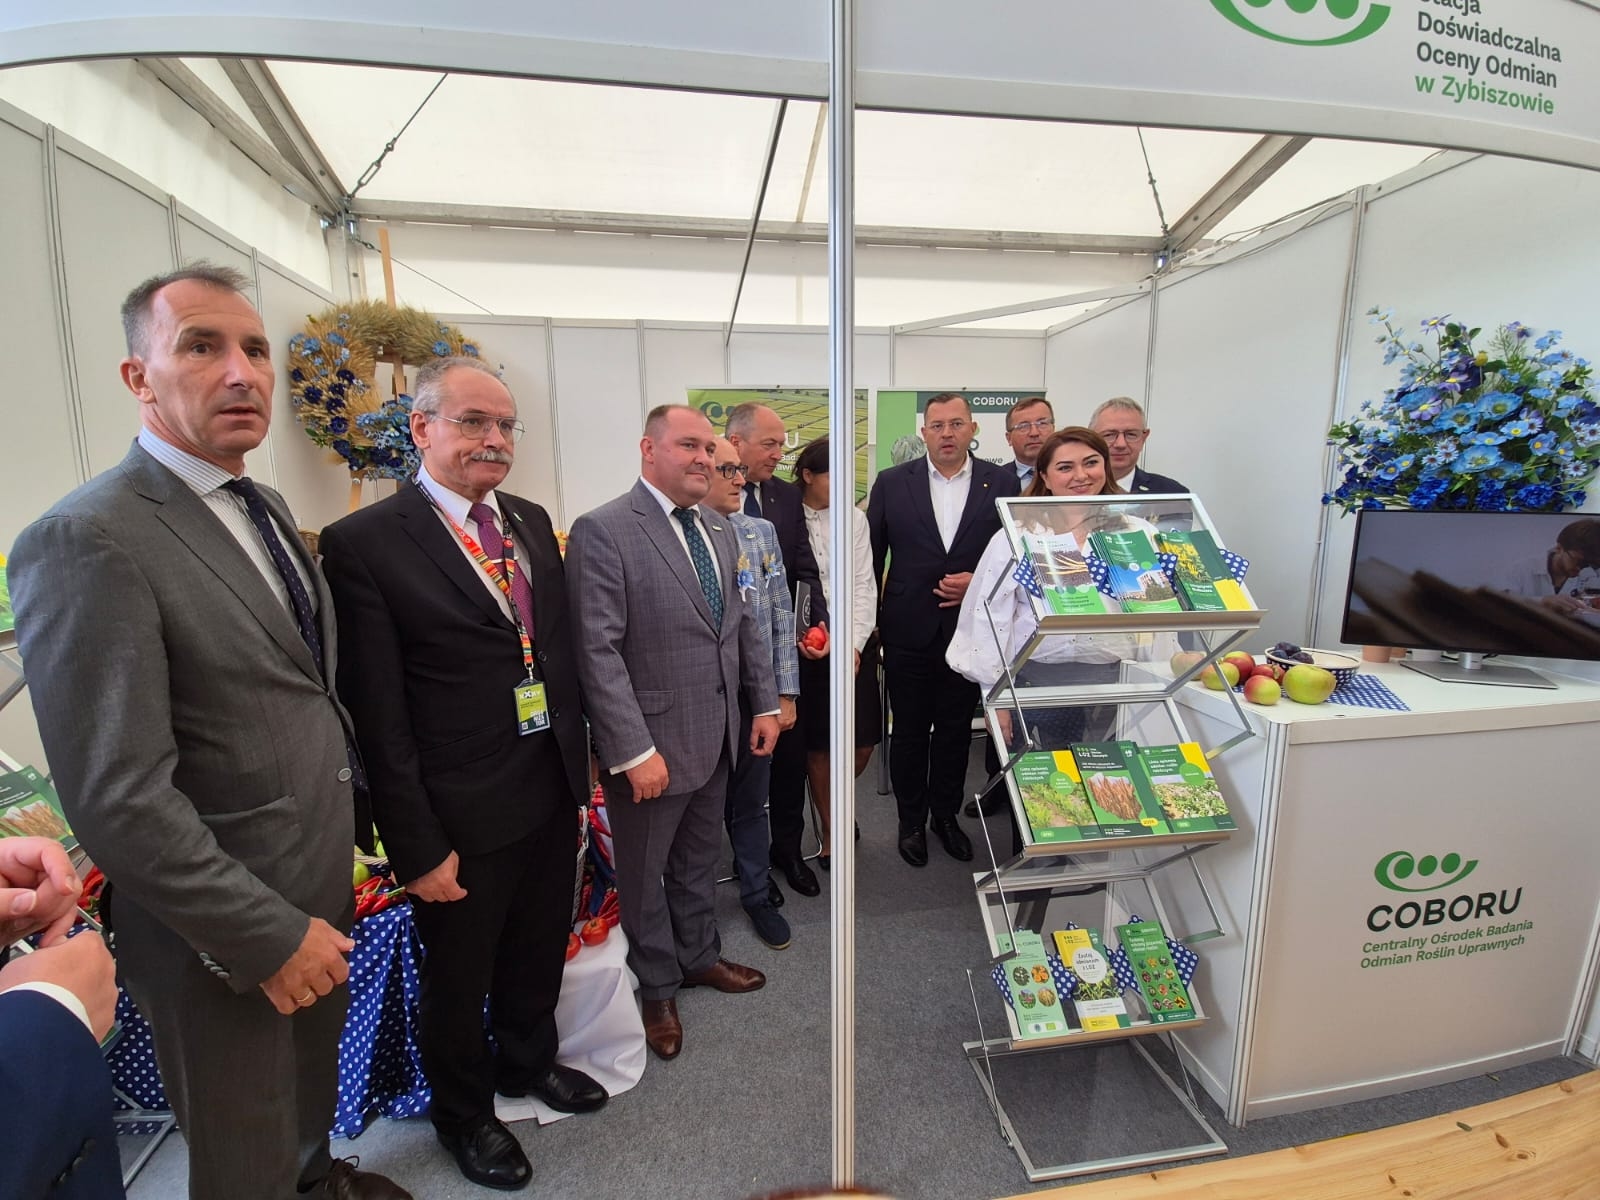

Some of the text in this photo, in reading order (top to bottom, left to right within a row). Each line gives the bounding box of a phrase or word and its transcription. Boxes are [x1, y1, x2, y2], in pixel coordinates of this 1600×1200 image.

[1418, 11, 1561, 62] Doświadczalna
[1416, 41, 1557, 88] Oceny Odmian
[1415, 75, 1554, 114] w Zybiszowie
[973, 397, 1018, 406] COBORU
[1366, 887, 1523, 932] COBORU
[1360, 934, 1525, 969] Odmian Roślin Uprawnych
[1362, 919, 1534, 954] Centralny Ośrodek Badania
